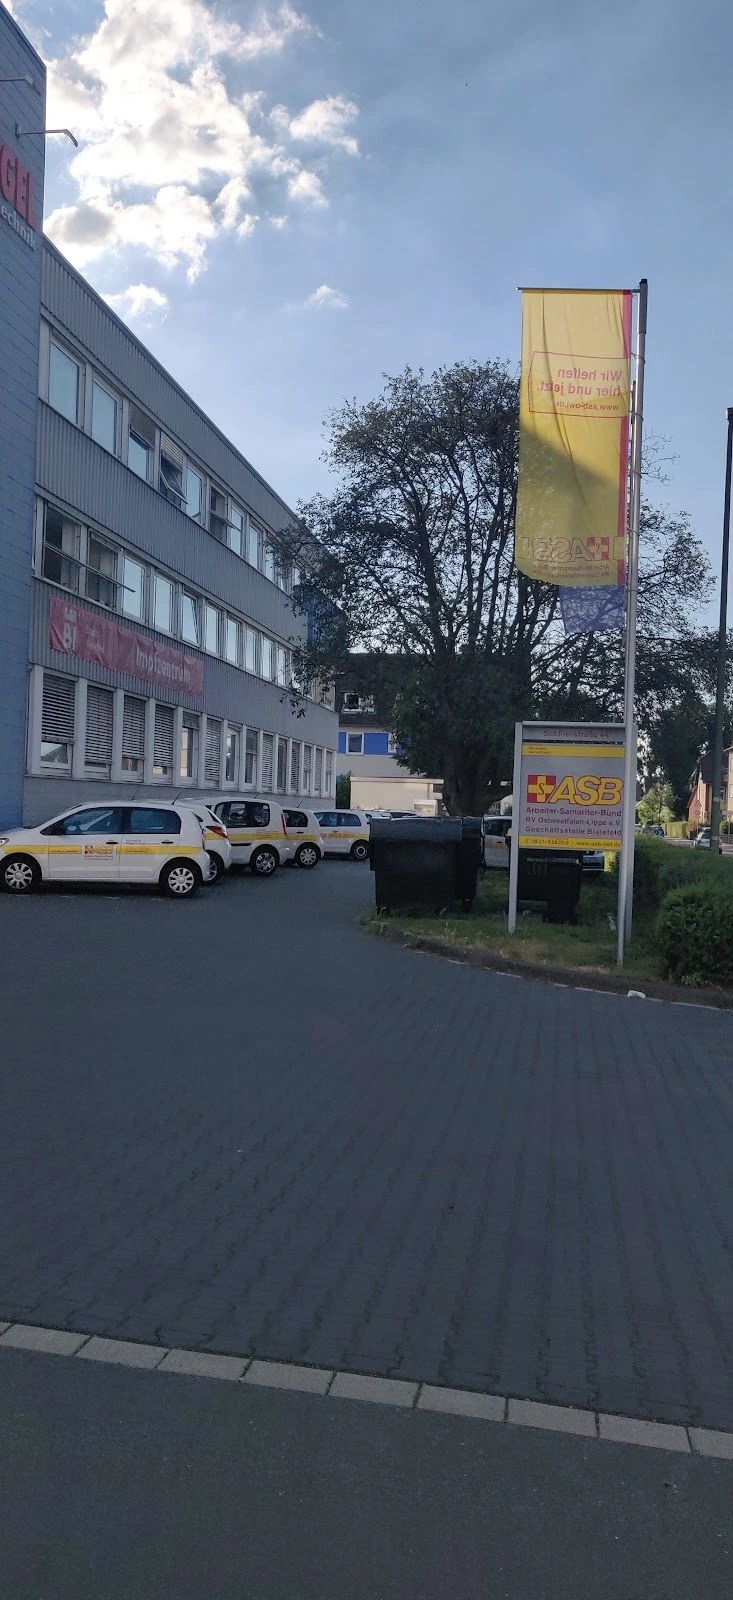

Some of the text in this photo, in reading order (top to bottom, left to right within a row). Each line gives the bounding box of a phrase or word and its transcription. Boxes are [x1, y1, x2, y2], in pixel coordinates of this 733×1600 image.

[0, 202, 36, 251] echnik
[136, 645, 191, 684] Impfzentrum
[543, 730, 598, 738] Schillerstraße
[548, 775, 624, 806] ASB
[525, 806, 622, 817] Arbeiter-Samariter-Bund
[525, 816, 623, 827] RV Ostwestfalen-Lippe e.V.
[525, 825, 622, 836] Geschäftsstelle Bielefeld
